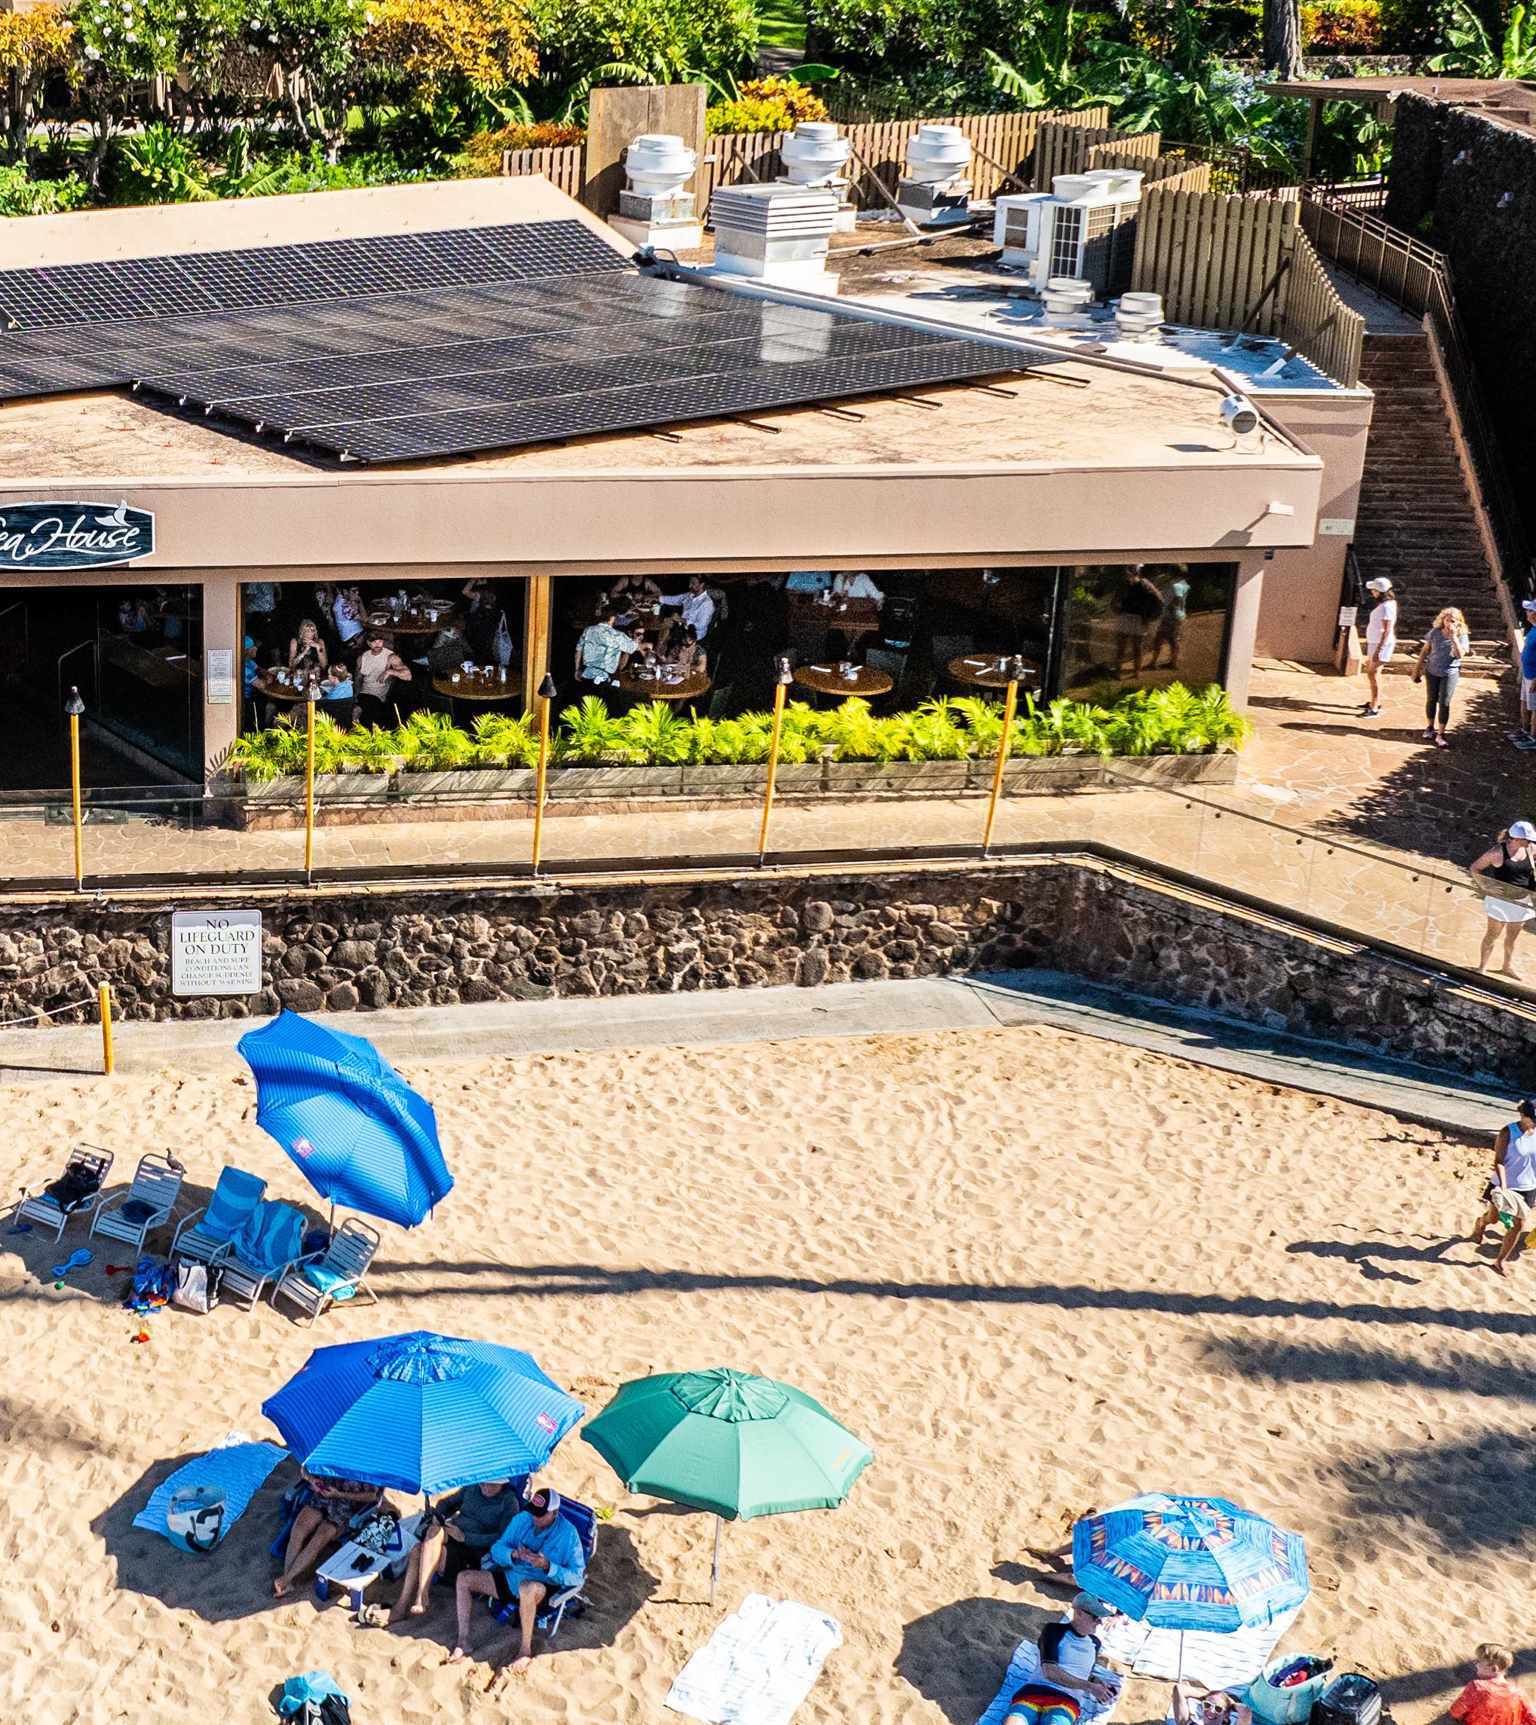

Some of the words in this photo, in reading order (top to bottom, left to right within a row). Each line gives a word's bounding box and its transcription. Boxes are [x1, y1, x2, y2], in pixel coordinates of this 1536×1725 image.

[26, 515, 141, 556] House
[206, 919, 230, 930] NO
[180, 931, 255, 943] LIFEGUARD
[185, 944, 206, 955] ON
[210, 943, 248, 955] DUTY
